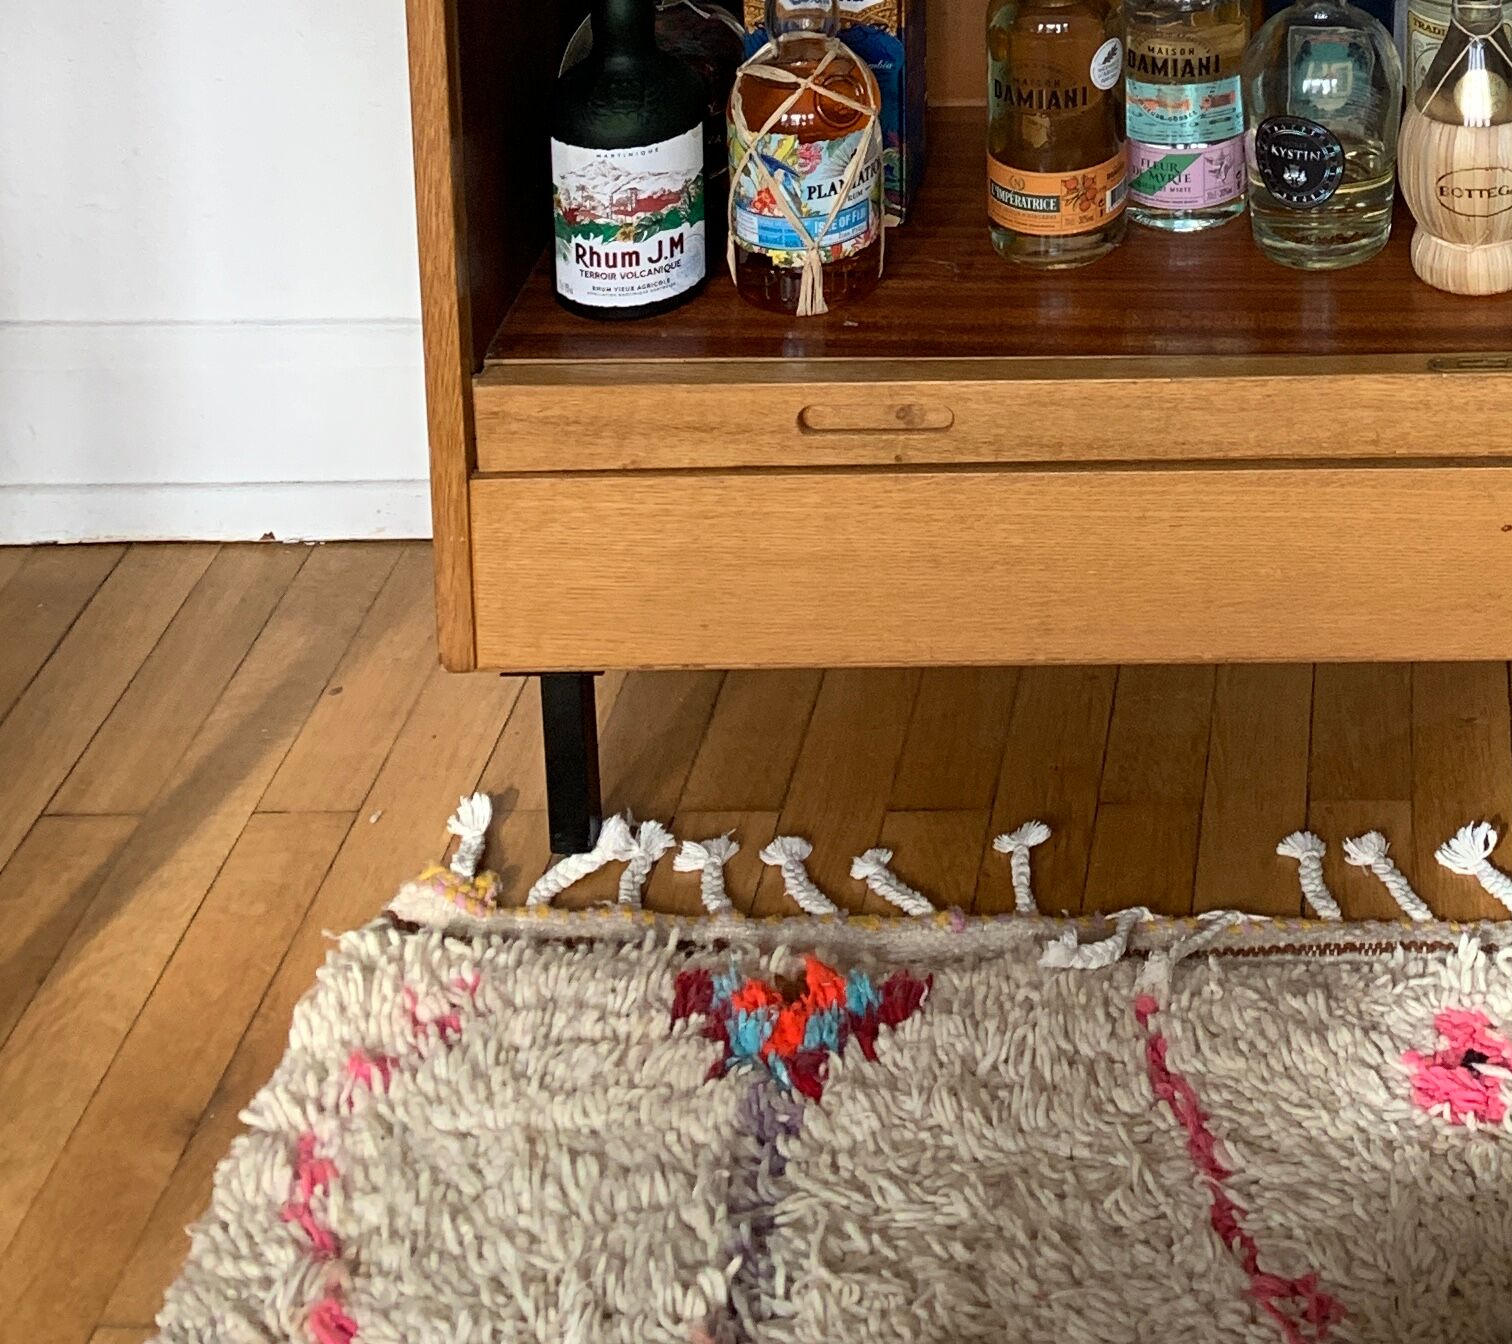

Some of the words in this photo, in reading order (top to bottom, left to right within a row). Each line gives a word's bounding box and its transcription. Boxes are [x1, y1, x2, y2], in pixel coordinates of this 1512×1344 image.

[1148, 45, 1195, 55] MAISON
[1127, 49, 1220, 78] DAMIANI
[994, 78, 1087, 110] DAMIANI
[596, 147, 660, 158] MARTINIQUE
[1270, 144, 1321, 162] KYSTIN
[1141, 158, 1180, 174] FLEUR
[806, 157, 881, 201] PLAATIO
[1149, 171, 1191, 185] MYRTE
[991, 182, 1057, 211] L'IMPÉRATRICE
[814, 219, 838, 234] ISE
[838, 214, 850, 227] OF
[575, 242, 640, 269] Rhum
[647, 232, 684, 264] J.M
[579, 269, 617, 281] TERROIR
[619, 258, 681, 281] VOLCANIQUE
[592, 285, 612, 293] RHUM
[613, 285, 635, 293] VIEUX
[636, 278, 671, 291] AGRICOLE
